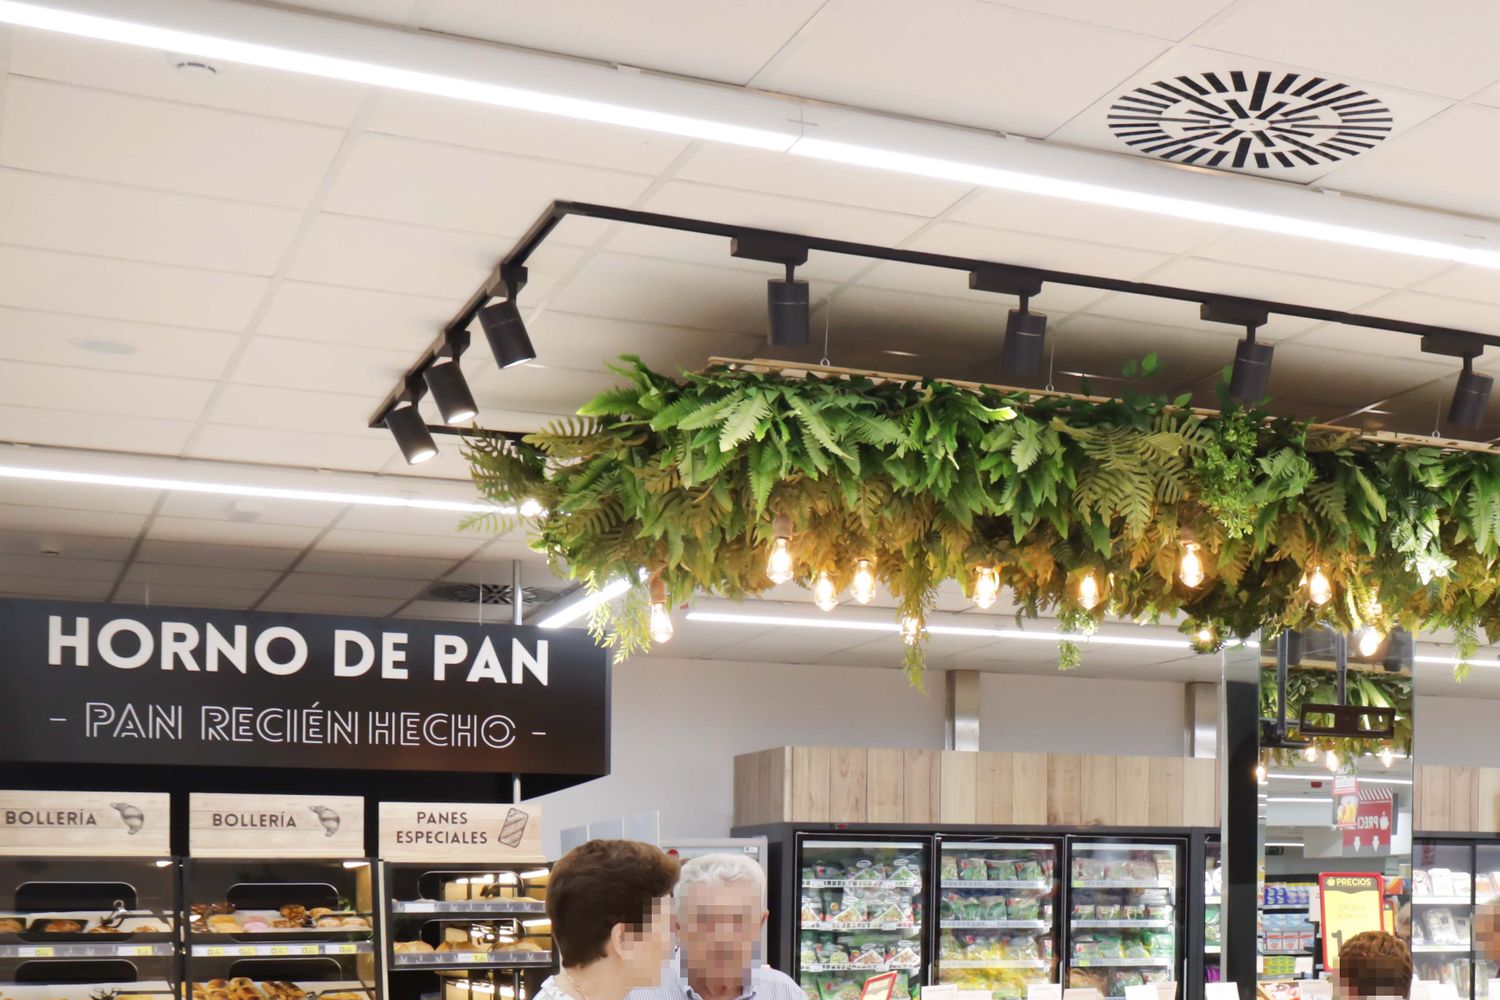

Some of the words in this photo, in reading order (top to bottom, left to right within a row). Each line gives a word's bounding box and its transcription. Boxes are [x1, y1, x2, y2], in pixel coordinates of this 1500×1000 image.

[48, 615, 308, 676] HORNO
[333, 629, 408, 680] DE
[433, 634, 550, 686] PAN
[85, 702, 183, 740] PAN
[201, 701, 360, 746] RECIÉN
[368, 709, 516, 749] HECHO
[5, 808, 97, 827] BOLLERÍA
[212, 809, 297, 829] BOLLERÍA
[417, 811, 468, 825] PANES
[396, 830, 488, 844] ESPECIALES
[1336, 878, 1372, 887] PRECIOS
